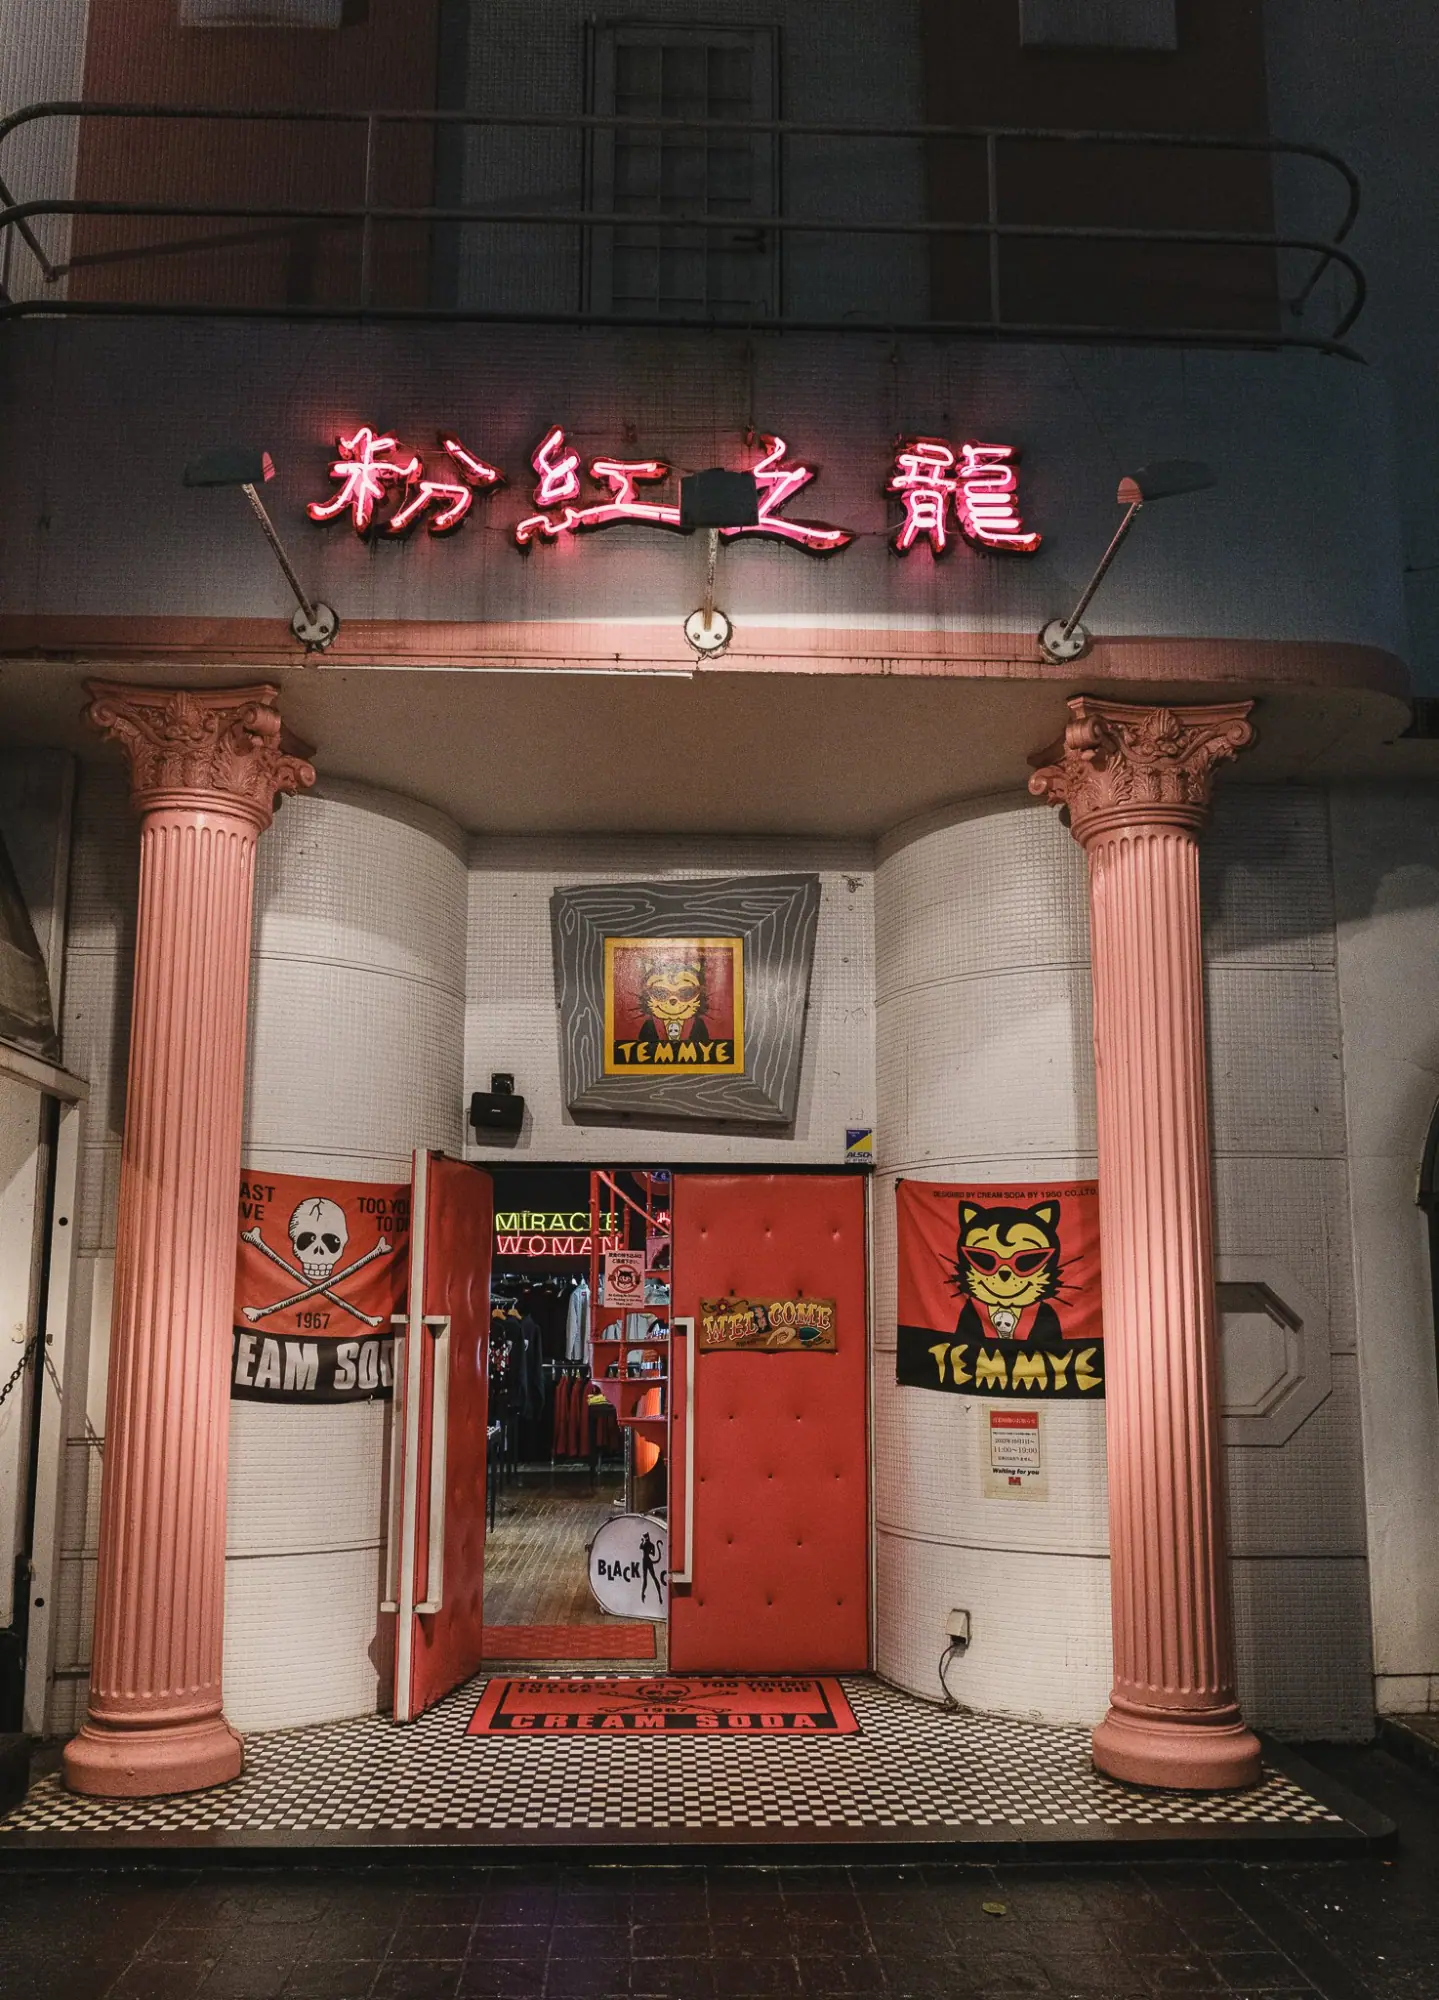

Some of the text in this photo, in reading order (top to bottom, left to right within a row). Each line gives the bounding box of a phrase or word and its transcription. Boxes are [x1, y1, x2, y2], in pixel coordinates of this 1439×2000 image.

[618, 1042, 730, 1063] TEMMYE
[240, 1182, 275, 1202] AST
[239, 1202, 264, 1220] VE
[357, 1197, 410, 1215] TOO YO
[376, 1216, 392, 1232] TO
[497, 1235, 618, 1255] WOMAN
[295, 1312, 330, 1330] 1967
[703, 1302, 832, 1343] WELCOME
[233, 1333, 319, 1390] EAM
[928, 1343, 1103, 1391] TEMMYE
[598, 1559, 640, 1582] BLACK
[511, 1714, 816, 1727] CREAM SODA
